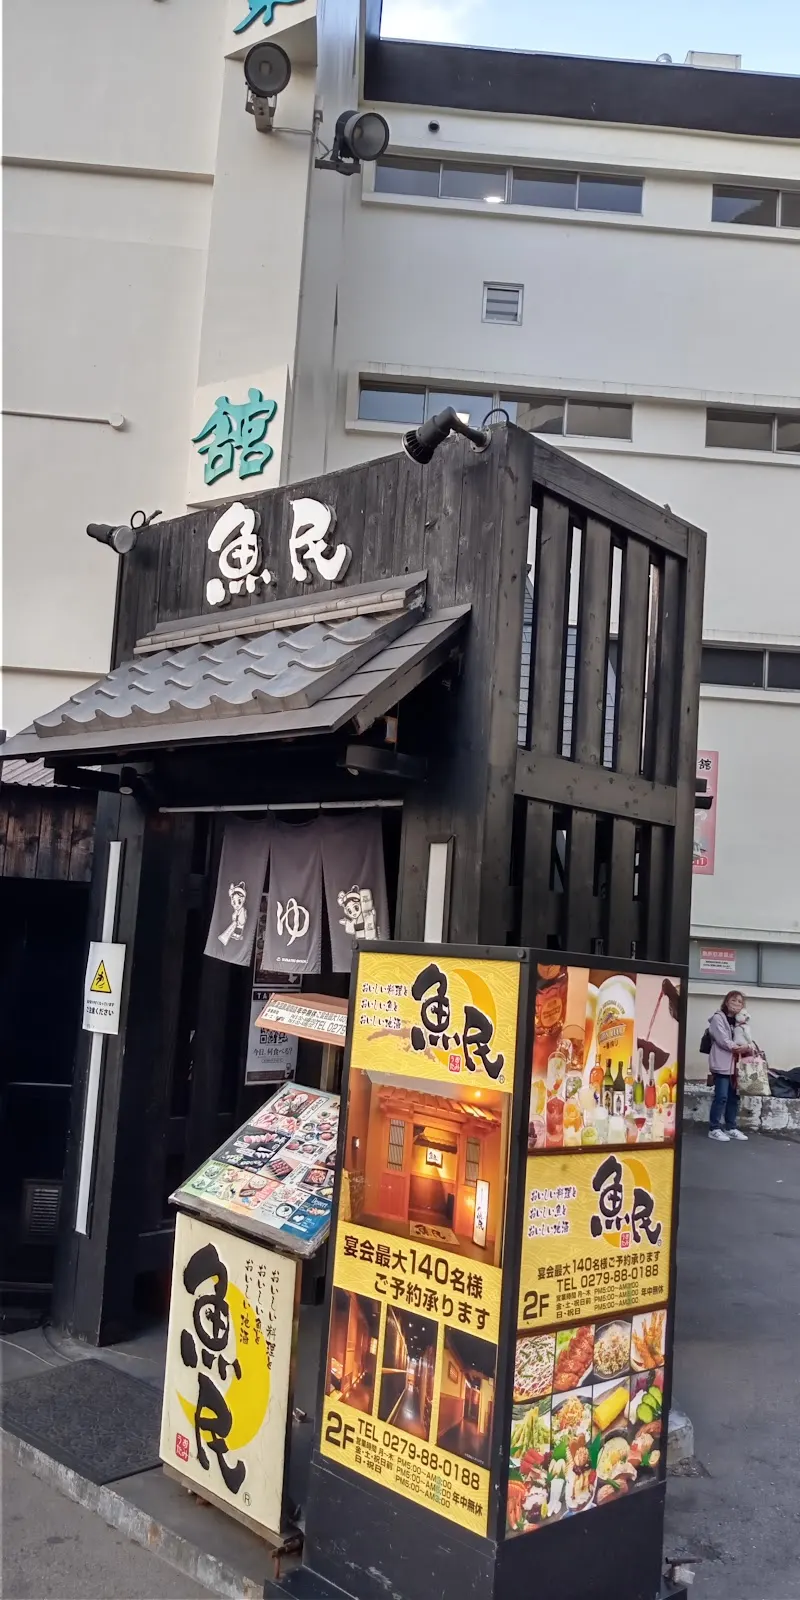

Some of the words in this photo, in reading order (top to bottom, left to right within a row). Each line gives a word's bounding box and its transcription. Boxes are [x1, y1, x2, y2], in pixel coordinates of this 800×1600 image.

[191, 387, 278, 486] 館
[206, 498, 350, 607] 魚民
[276, 898, 310, 946] ゆ
[257, 992, 271, 1000] TA
[361, 982, 408, 997] おいしい料理と
[360, 999, 398, 1012] おいしい魚と
[411, 963, 504, 1079] 魚民
[359, 1014, 402, 1029] おいしい地酒
[530, 1187, 577, 1202] おいしい料理と
[590, 1155, 662, 1244] 魚民
[529, 1204, 567, 1219] おいしい魚と
[528, 1221, 569, 1237] おいしい地酒
[344, 1235, 483, 1300] 宴会最大140名様
[537, 1250, 661, 1281] 宴会最大140名様ご予約承ります
[557, 1278, 577, 1293] TEL
[581, 1265, 659, 1288] 0279-88-0188
[240, 1259, 254, 1345] おいしい地酒
[253, 1264, 267, 1345] おいしい魚と
[374, 1273, 491, 1330] ご予約承ります
[523, 1290, 549, 1320] 2F
[641, 1285, 664, 1297] 年中無休
[266, 1270, 280, 1370] おいしい料理と
[556, 1307, 581, 1319] 日・祝日
[181, 1243, 246, 1494] 魚民
[325, 1410, 355, 1450] 2F
[355, 1455, 382, 1475] 日・祝日
[357, 1418, 379, 1443] TEL
[382, 1430, 480, 1491] 0279-88-0188
[451, 1491, 483, 1517] 年中無休
